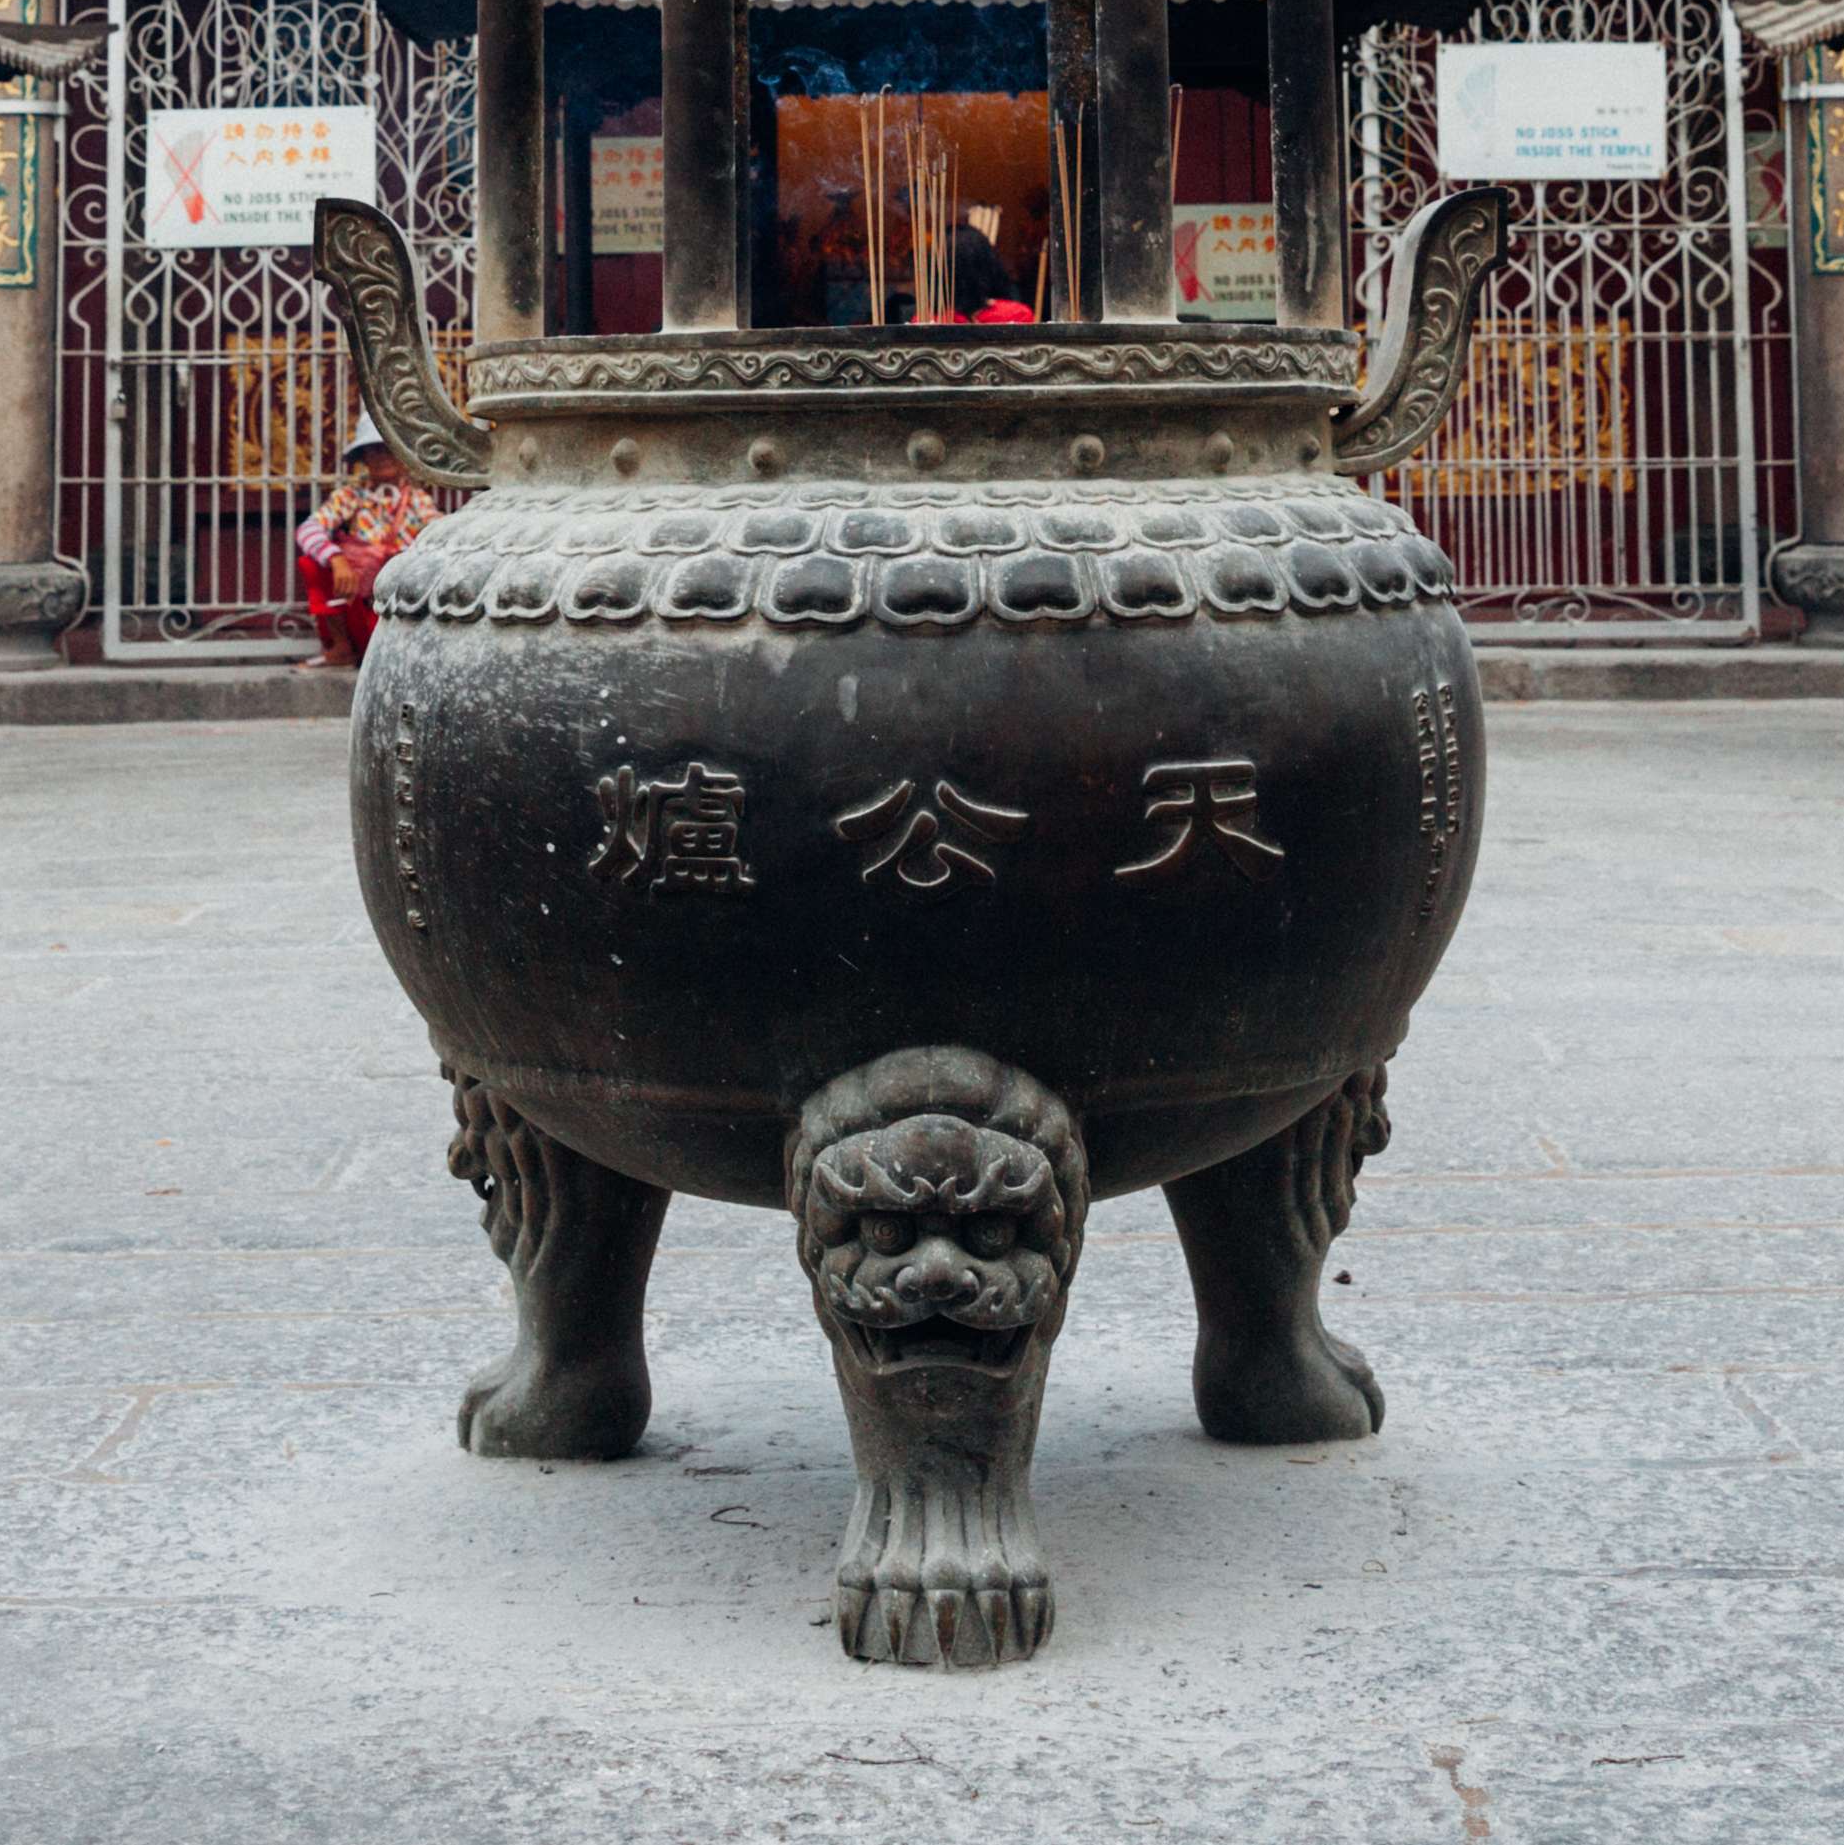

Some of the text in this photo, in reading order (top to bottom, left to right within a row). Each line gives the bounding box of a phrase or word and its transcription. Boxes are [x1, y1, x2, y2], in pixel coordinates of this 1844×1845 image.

[1516, 127, 1619, 138] NO JOSS STICK
[1516, 144, 1652, 157] INSIDE THE TEMPLE
[224, 193, 242, 204] NO
[249, 193, 281, 204] JOSS
[224, 211, 270, 222] INSIDE
[278, 210, 302, 222] THE
[634, 207, 663, 218] STIC
[1213, 275, 1230, 286] NO
[1236, 275, 1263, 286] JOSS
